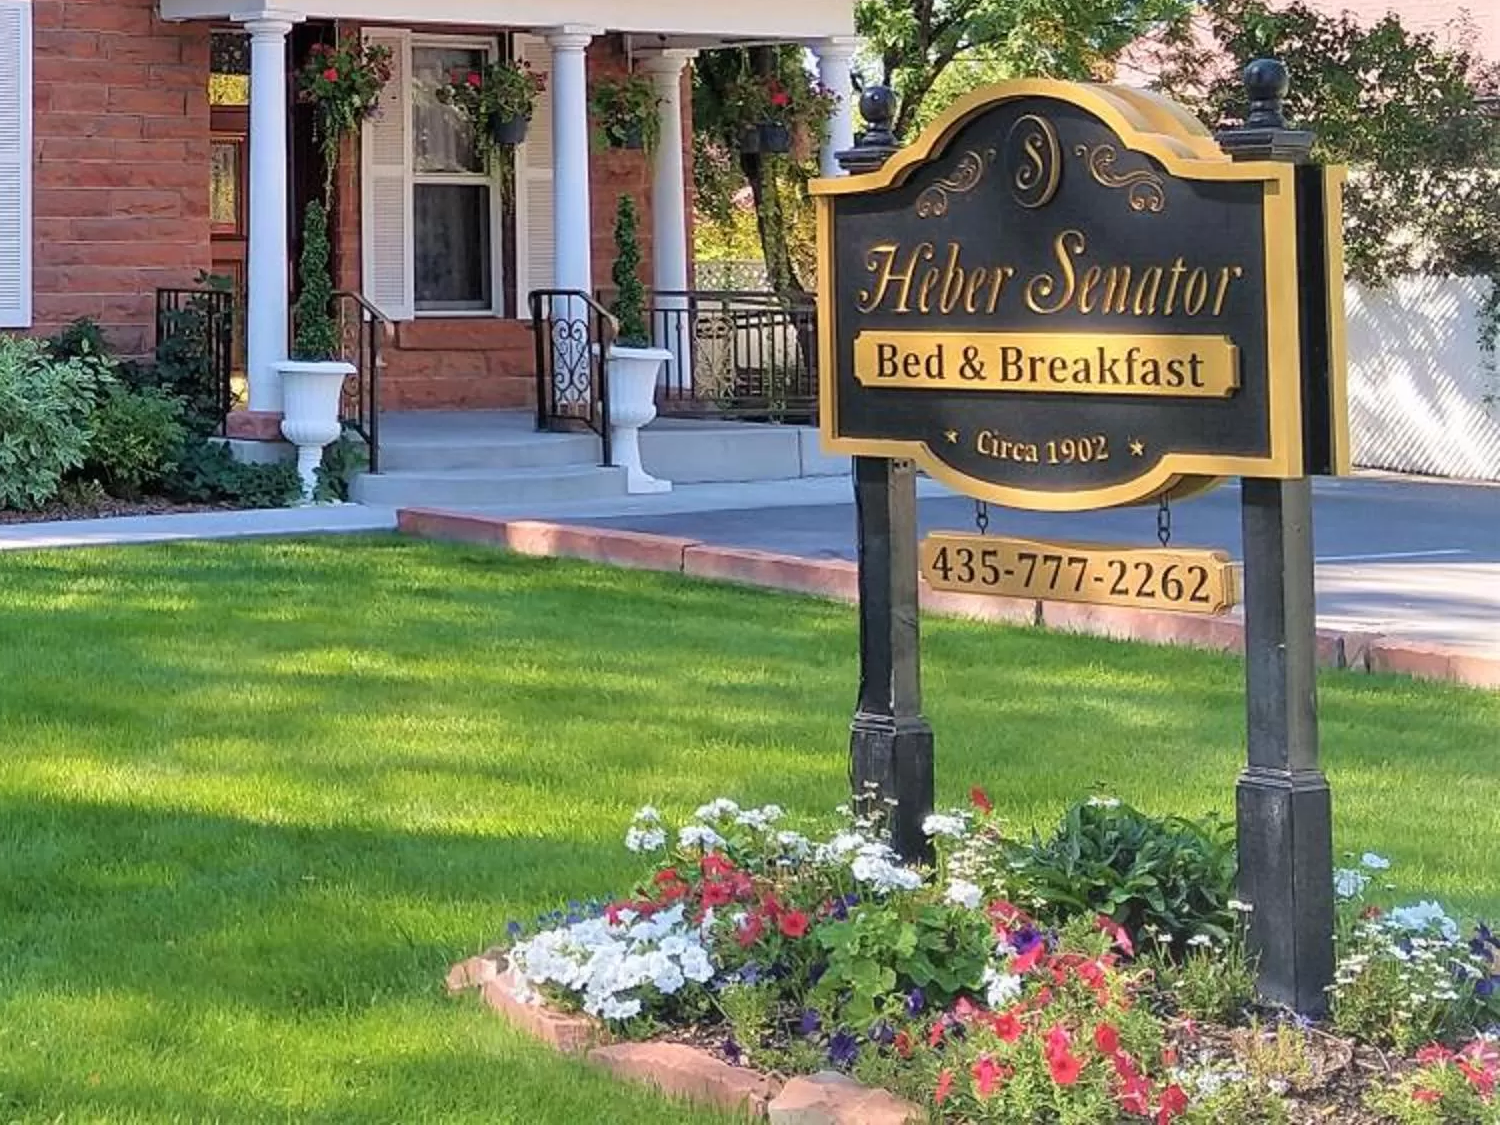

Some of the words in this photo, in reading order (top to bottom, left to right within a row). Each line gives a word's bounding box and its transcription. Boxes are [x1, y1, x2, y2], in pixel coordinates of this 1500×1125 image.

[1016, 132, 1043, 190] S
[855, 240, 1014, 314] Heber
[1024, 229, 1242, 316] Senator
[876, 343, 946, 381] Bed
[959, 345, 987, 382] &
[999, 345, 1205, 388] Breakfast
[976, 430, 1039, 462] Circa
[1046, 435, 1109, 464] 1902
[932, 546, 1211, 604] 435-777-2262
